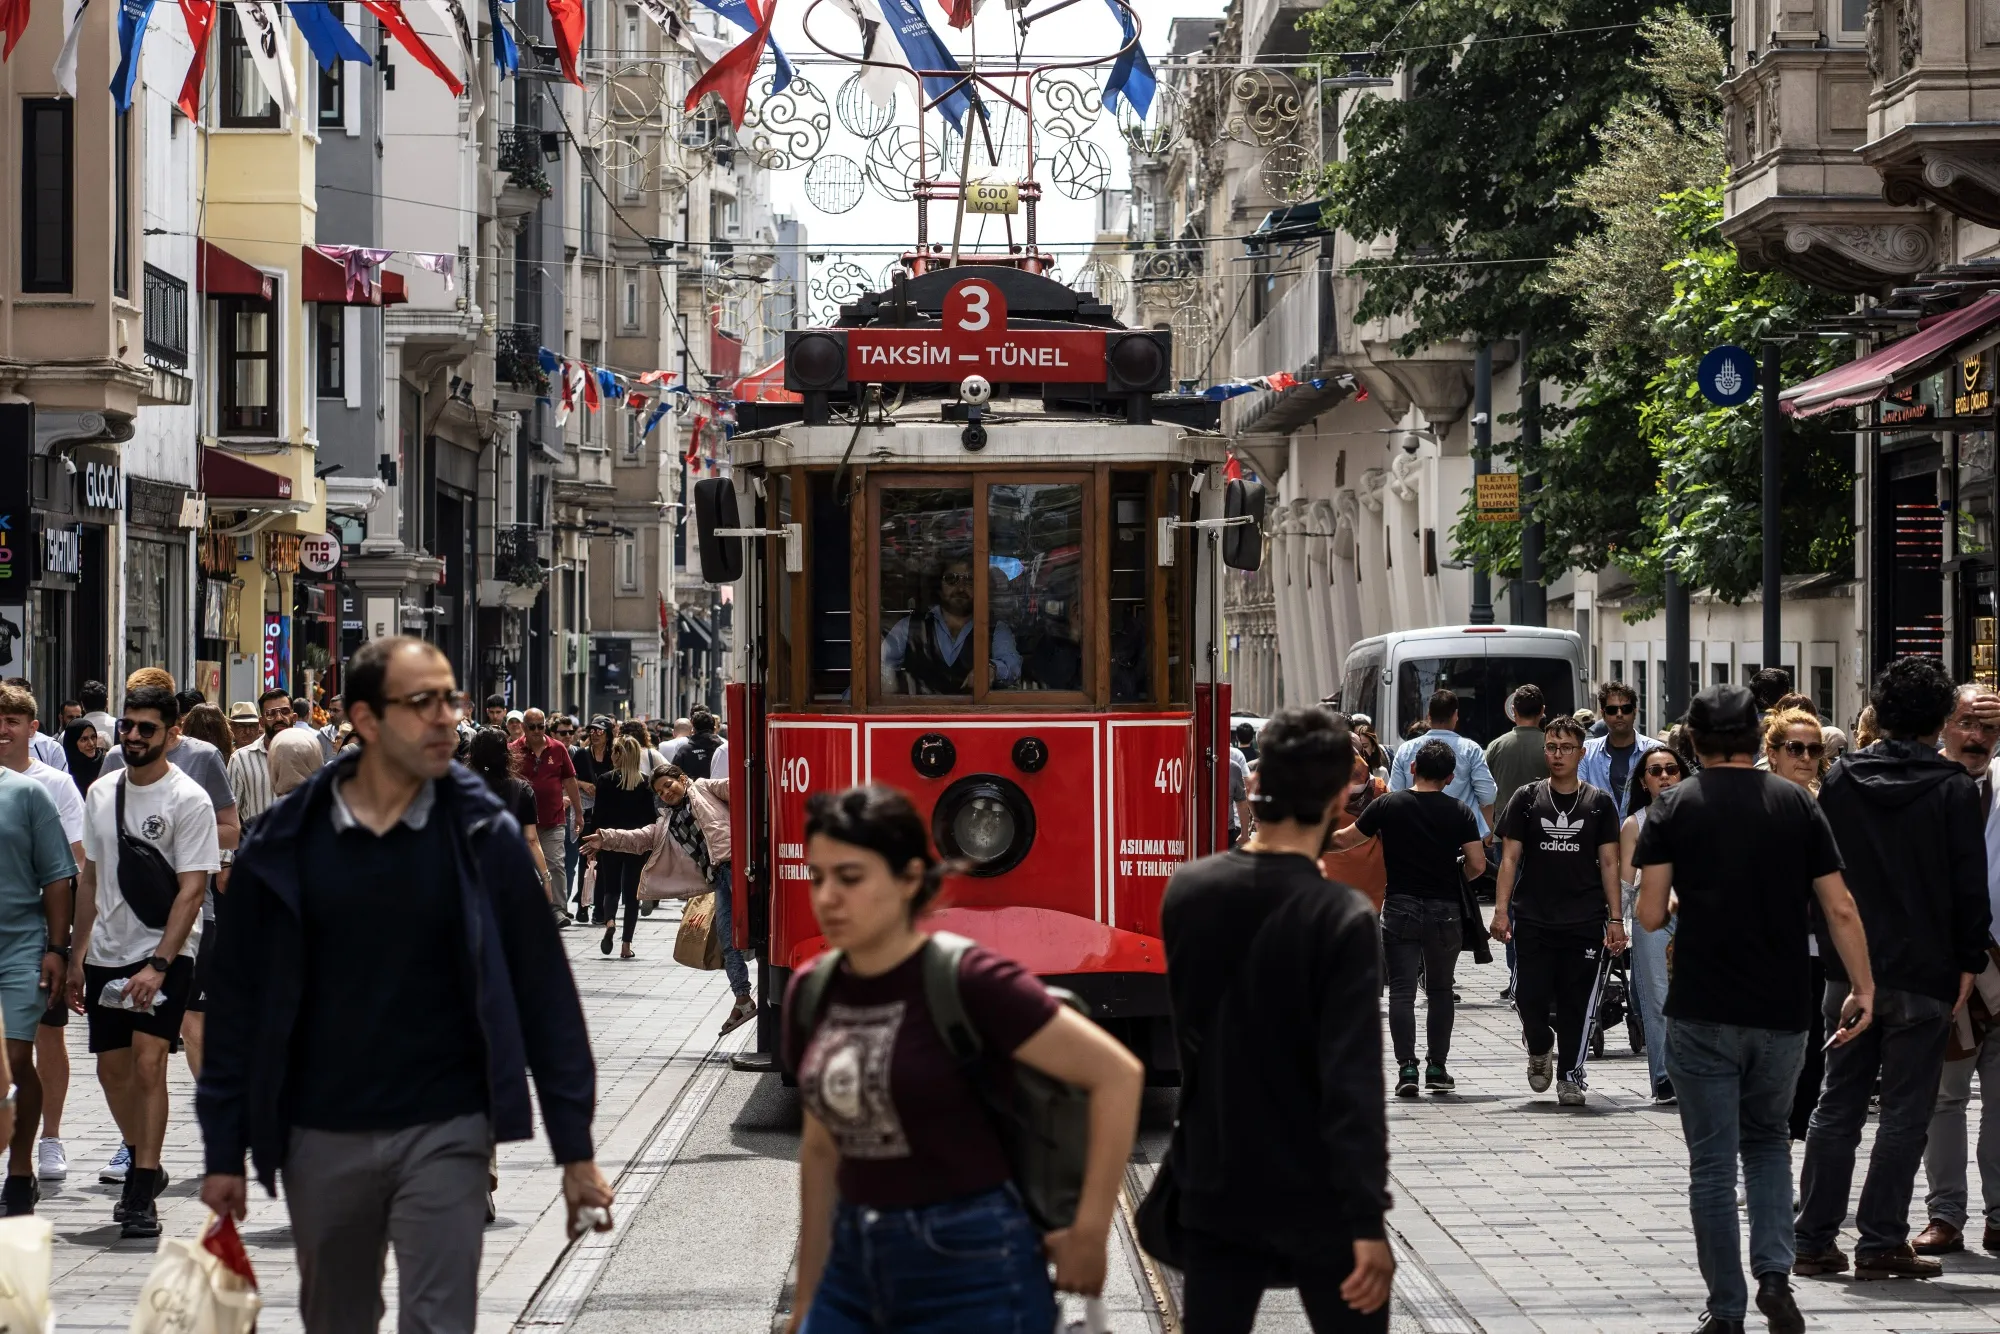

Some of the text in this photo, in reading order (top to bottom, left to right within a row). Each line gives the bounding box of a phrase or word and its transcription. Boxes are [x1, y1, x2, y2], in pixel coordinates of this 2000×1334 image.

[977, 187, 1008, 199] 600
[974, 201, 1011, 212] VOLT
[958, 285, 990, 331] 3
[857, 341, 951, 365] TAKSİM
[985, 342, 1069, 367] TÜNEL
[1478, 483, 1518, 491] TRAMVAY
[1481, 500, 1516, 508] DURAK
[780, 757, 809, 793] 410
[1154, 757, 1183, 793] 410
[1119, 839, 1166, 855] ASILMAK
[1539, 840, 1580, 852] adidas
[1120, 860, 1133, 876] VE
